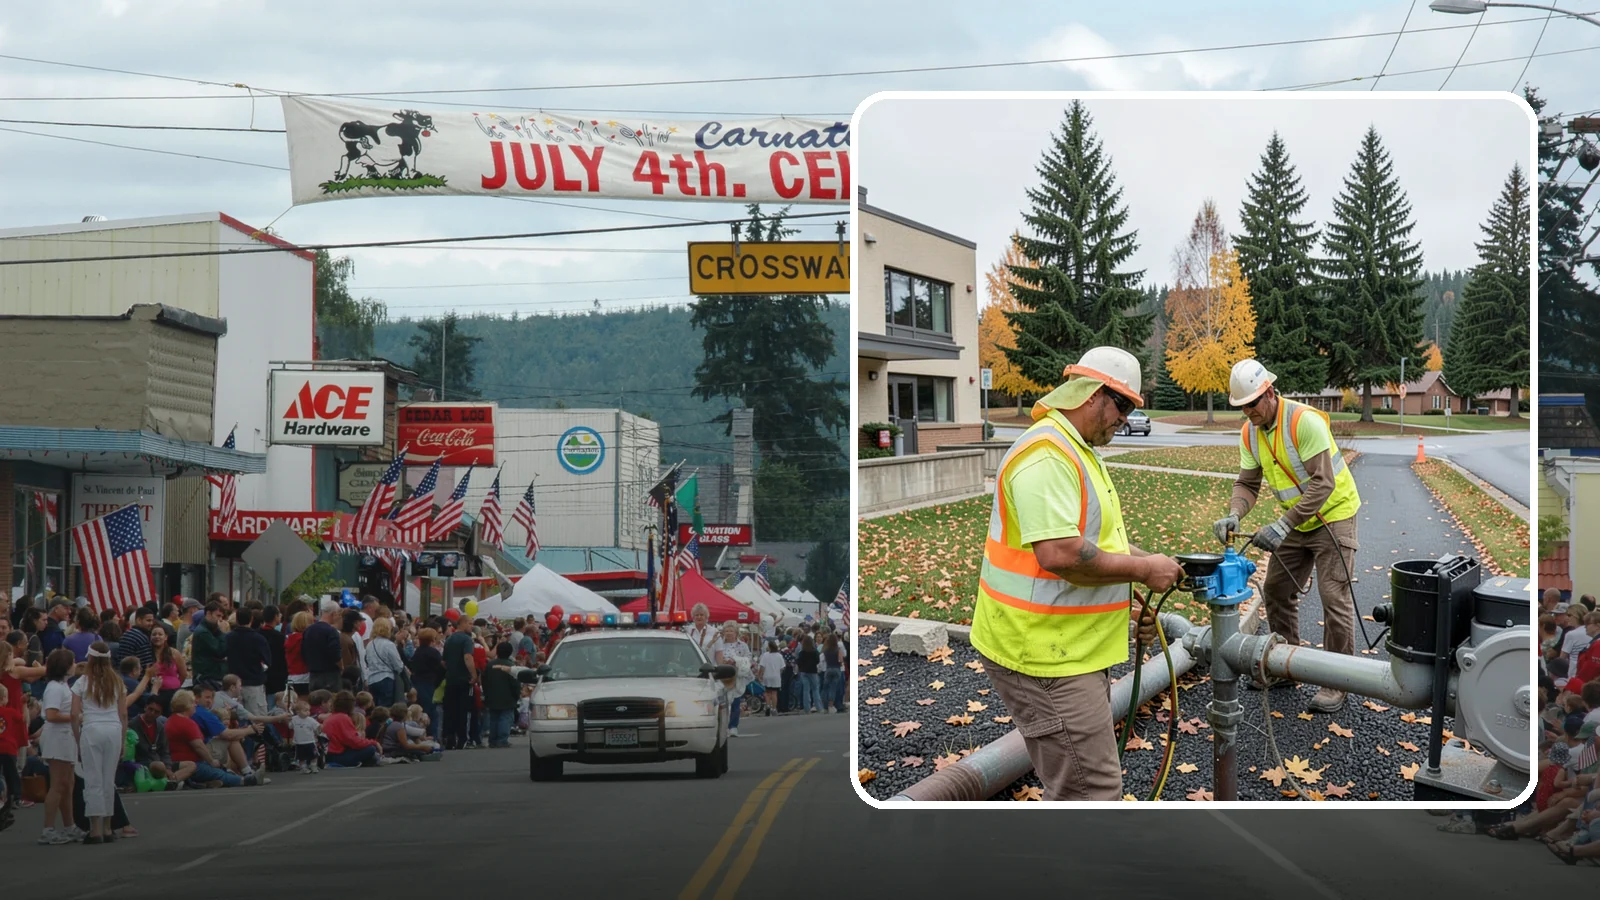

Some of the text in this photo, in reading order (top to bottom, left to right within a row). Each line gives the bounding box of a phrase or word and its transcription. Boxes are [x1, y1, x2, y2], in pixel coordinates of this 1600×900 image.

[695, 121, 850, 150] Carnat
[481, 141, 605, 192] JULY
[632, 150, 746, 198] 4th.
[697, 254, 850, 280] CROSSWA
[283, 380, 373, 420] ACE
[406, 410, 452, 422] CEDAR
[284, 421, 370, 436] Hardware
[83, 485, 155, 495] St. Vincent de Paul
[81, 503, 153, 522] THT
[212, 516, 331, 535] HARDARE
[688, 526, 741, 535] CRNATION
[699, 535, 730, 543] GLASS
